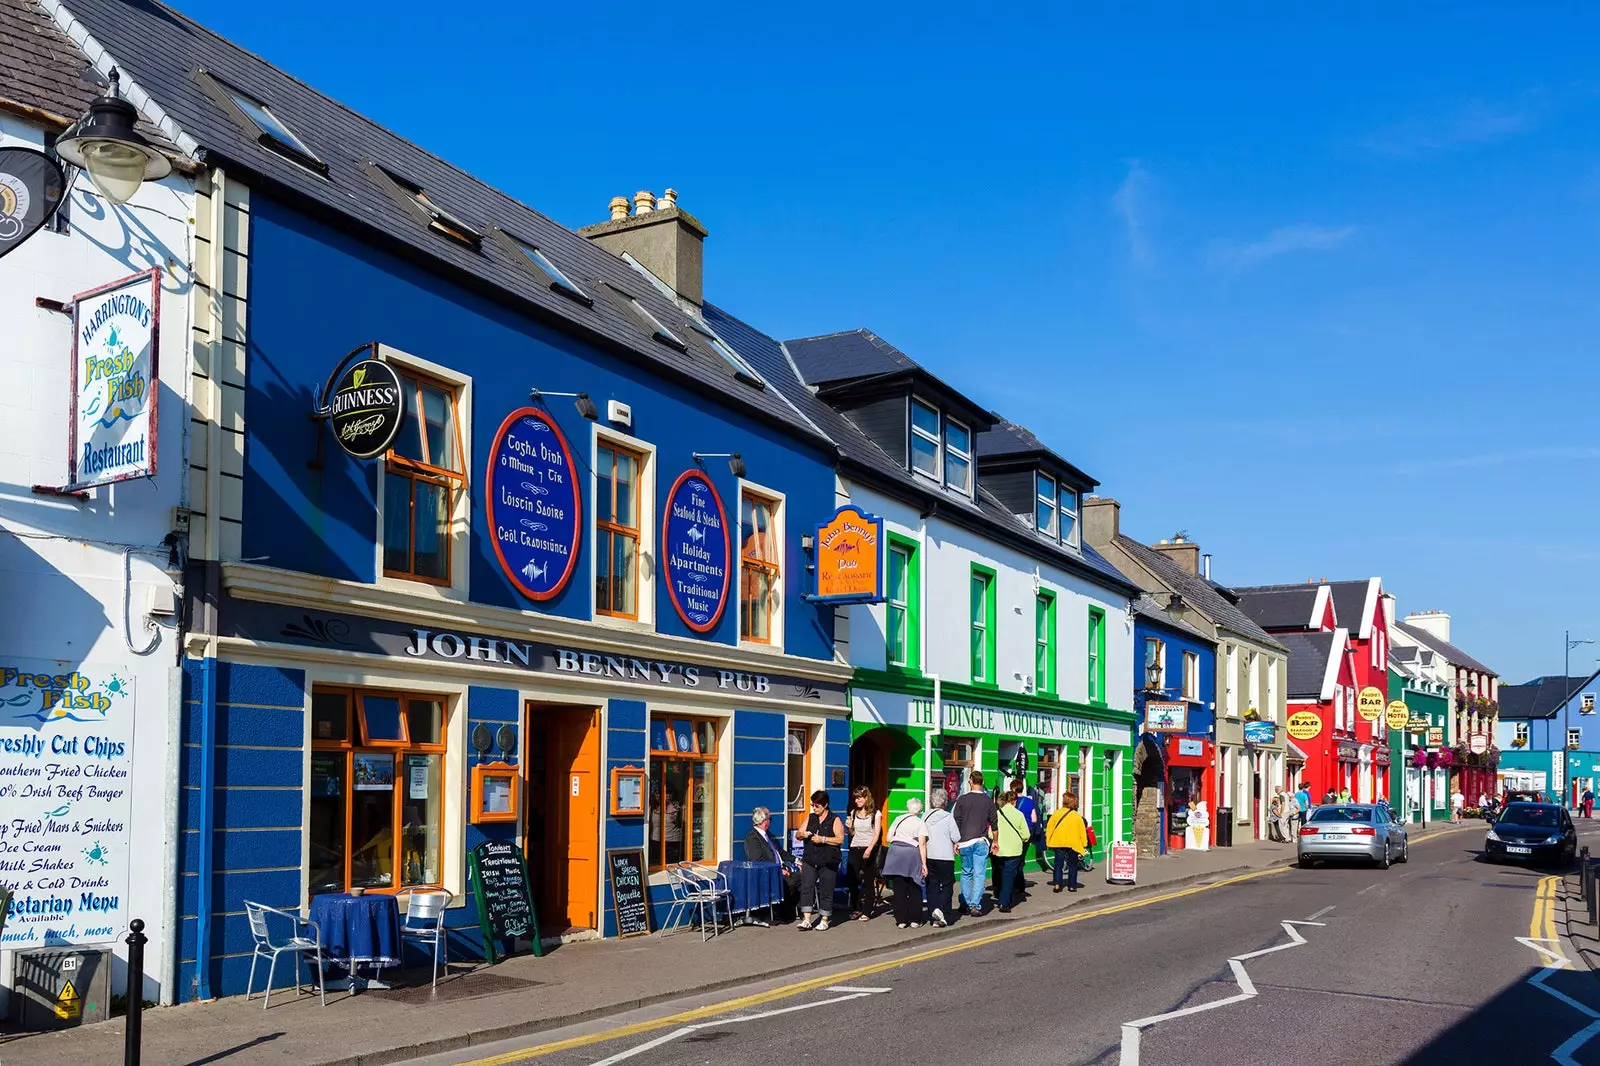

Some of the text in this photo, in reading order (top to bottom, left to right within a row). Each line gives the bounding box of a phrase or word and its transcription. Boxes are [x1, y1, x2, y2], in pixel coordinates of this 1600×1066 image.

[82, 293, 151, 346] HARRINGTON'S
[84, 346, 135, 391] Fresh
[105, 370, 145, 413] Fish
[332, 387, 393, 415] GUINNESS
[84, 434, 145, 474] Restaurant
[691, 493, 706, 508] Fine
[673, 502, 721, 529] Seafood & Steaks
[820, 527, 842, 550] John
[682, 542, 711, 563] Holiday
[670, 554, 723, 577] Apartments
[677, 581, 719, 600] Traditional
[687, 597, 709, 612] Music
[406, 628, 533, 666] JOHN
[556, 649, 770, 693] BENNY'S PUB
[37, 689, 112, 716] Fish
[1360, 698, 1382, 706] BAR
[913, 698, 1102, 742] TH DINGLE WOOLLEN COMPANY
[0, 734, 124, 760] reshly Cut Chips
[0, 763, 127, 781] outhern Fried Chicken
[20, 784, 52, 798] Irish
[55, 784, 83, 801] Beef
[86, 785, 124, 802] Burger
[11, 819, 42, 838] Fried
[42, 819, 69, 836] Mars
[71, 821, 80, 832] &
[81, 818, 124, 836] Snickers
[22, 841, 61, 853] Cream
[0, 858, 74, 873] Milk Shakes
[23, 880, 34, 890] &
[37, 877, 65, 890] Cold
[69, 876, 109, 889] Drinks
[8, 892, 119, 920] getarian Menu
[18, 914, 65, 924] Available
[2, 924, 114, 943] much, much, more
[64, 960, 75, 968] B1
